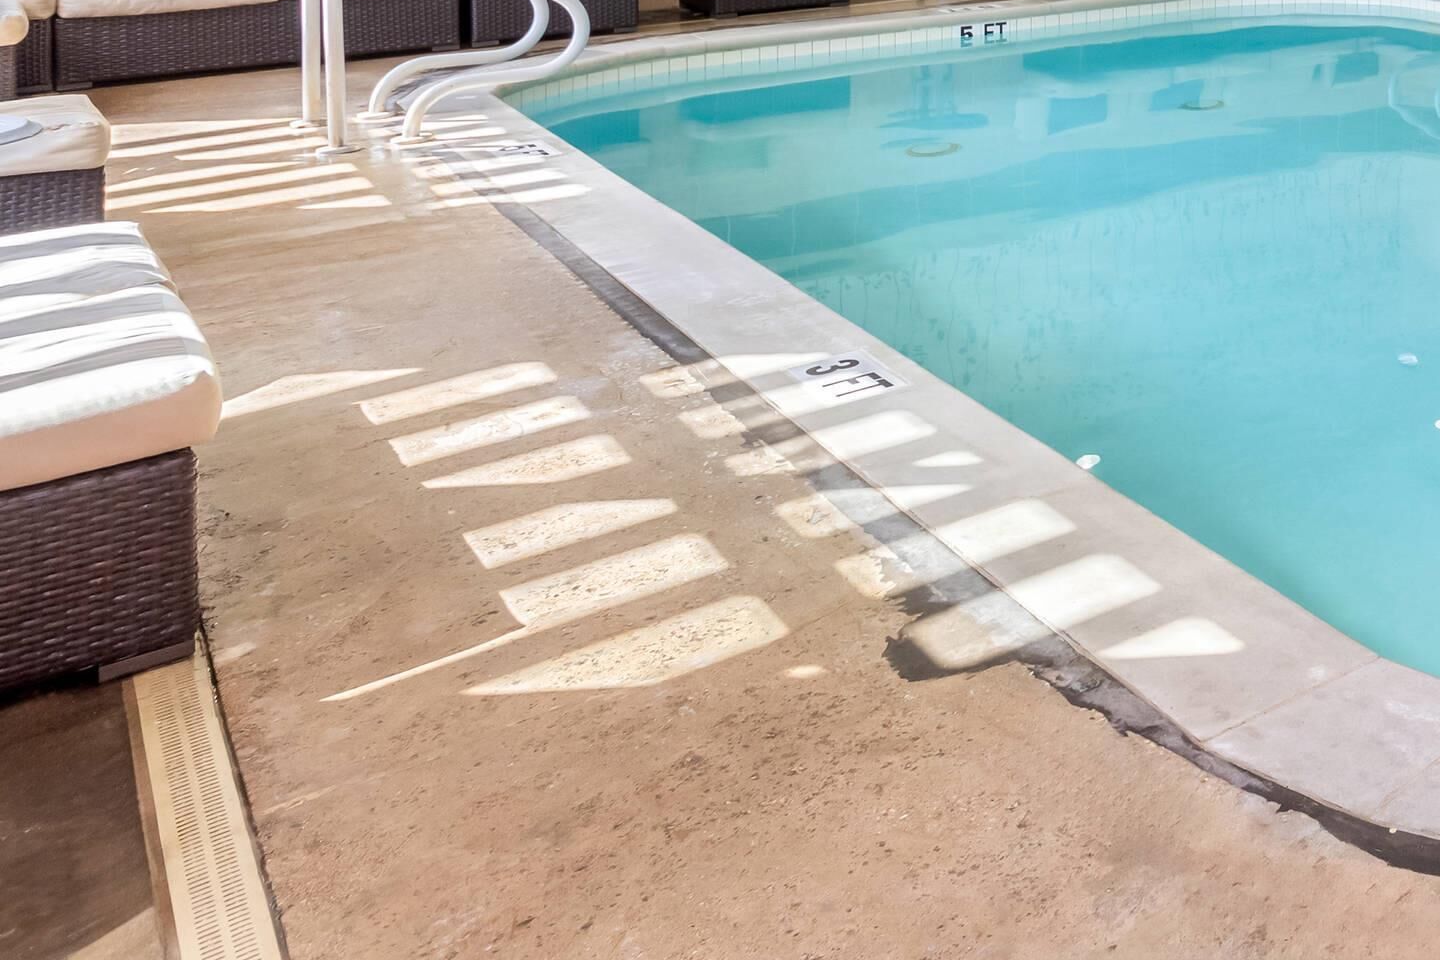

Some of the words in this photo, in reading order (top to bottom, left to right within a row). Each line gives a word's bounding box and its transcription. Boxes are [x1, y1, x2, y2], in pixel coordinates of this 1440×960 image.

[984, 21, 1007, 40] FT
[805, 359, 860, 376] 3
[821, 372, 895, 398] FT
